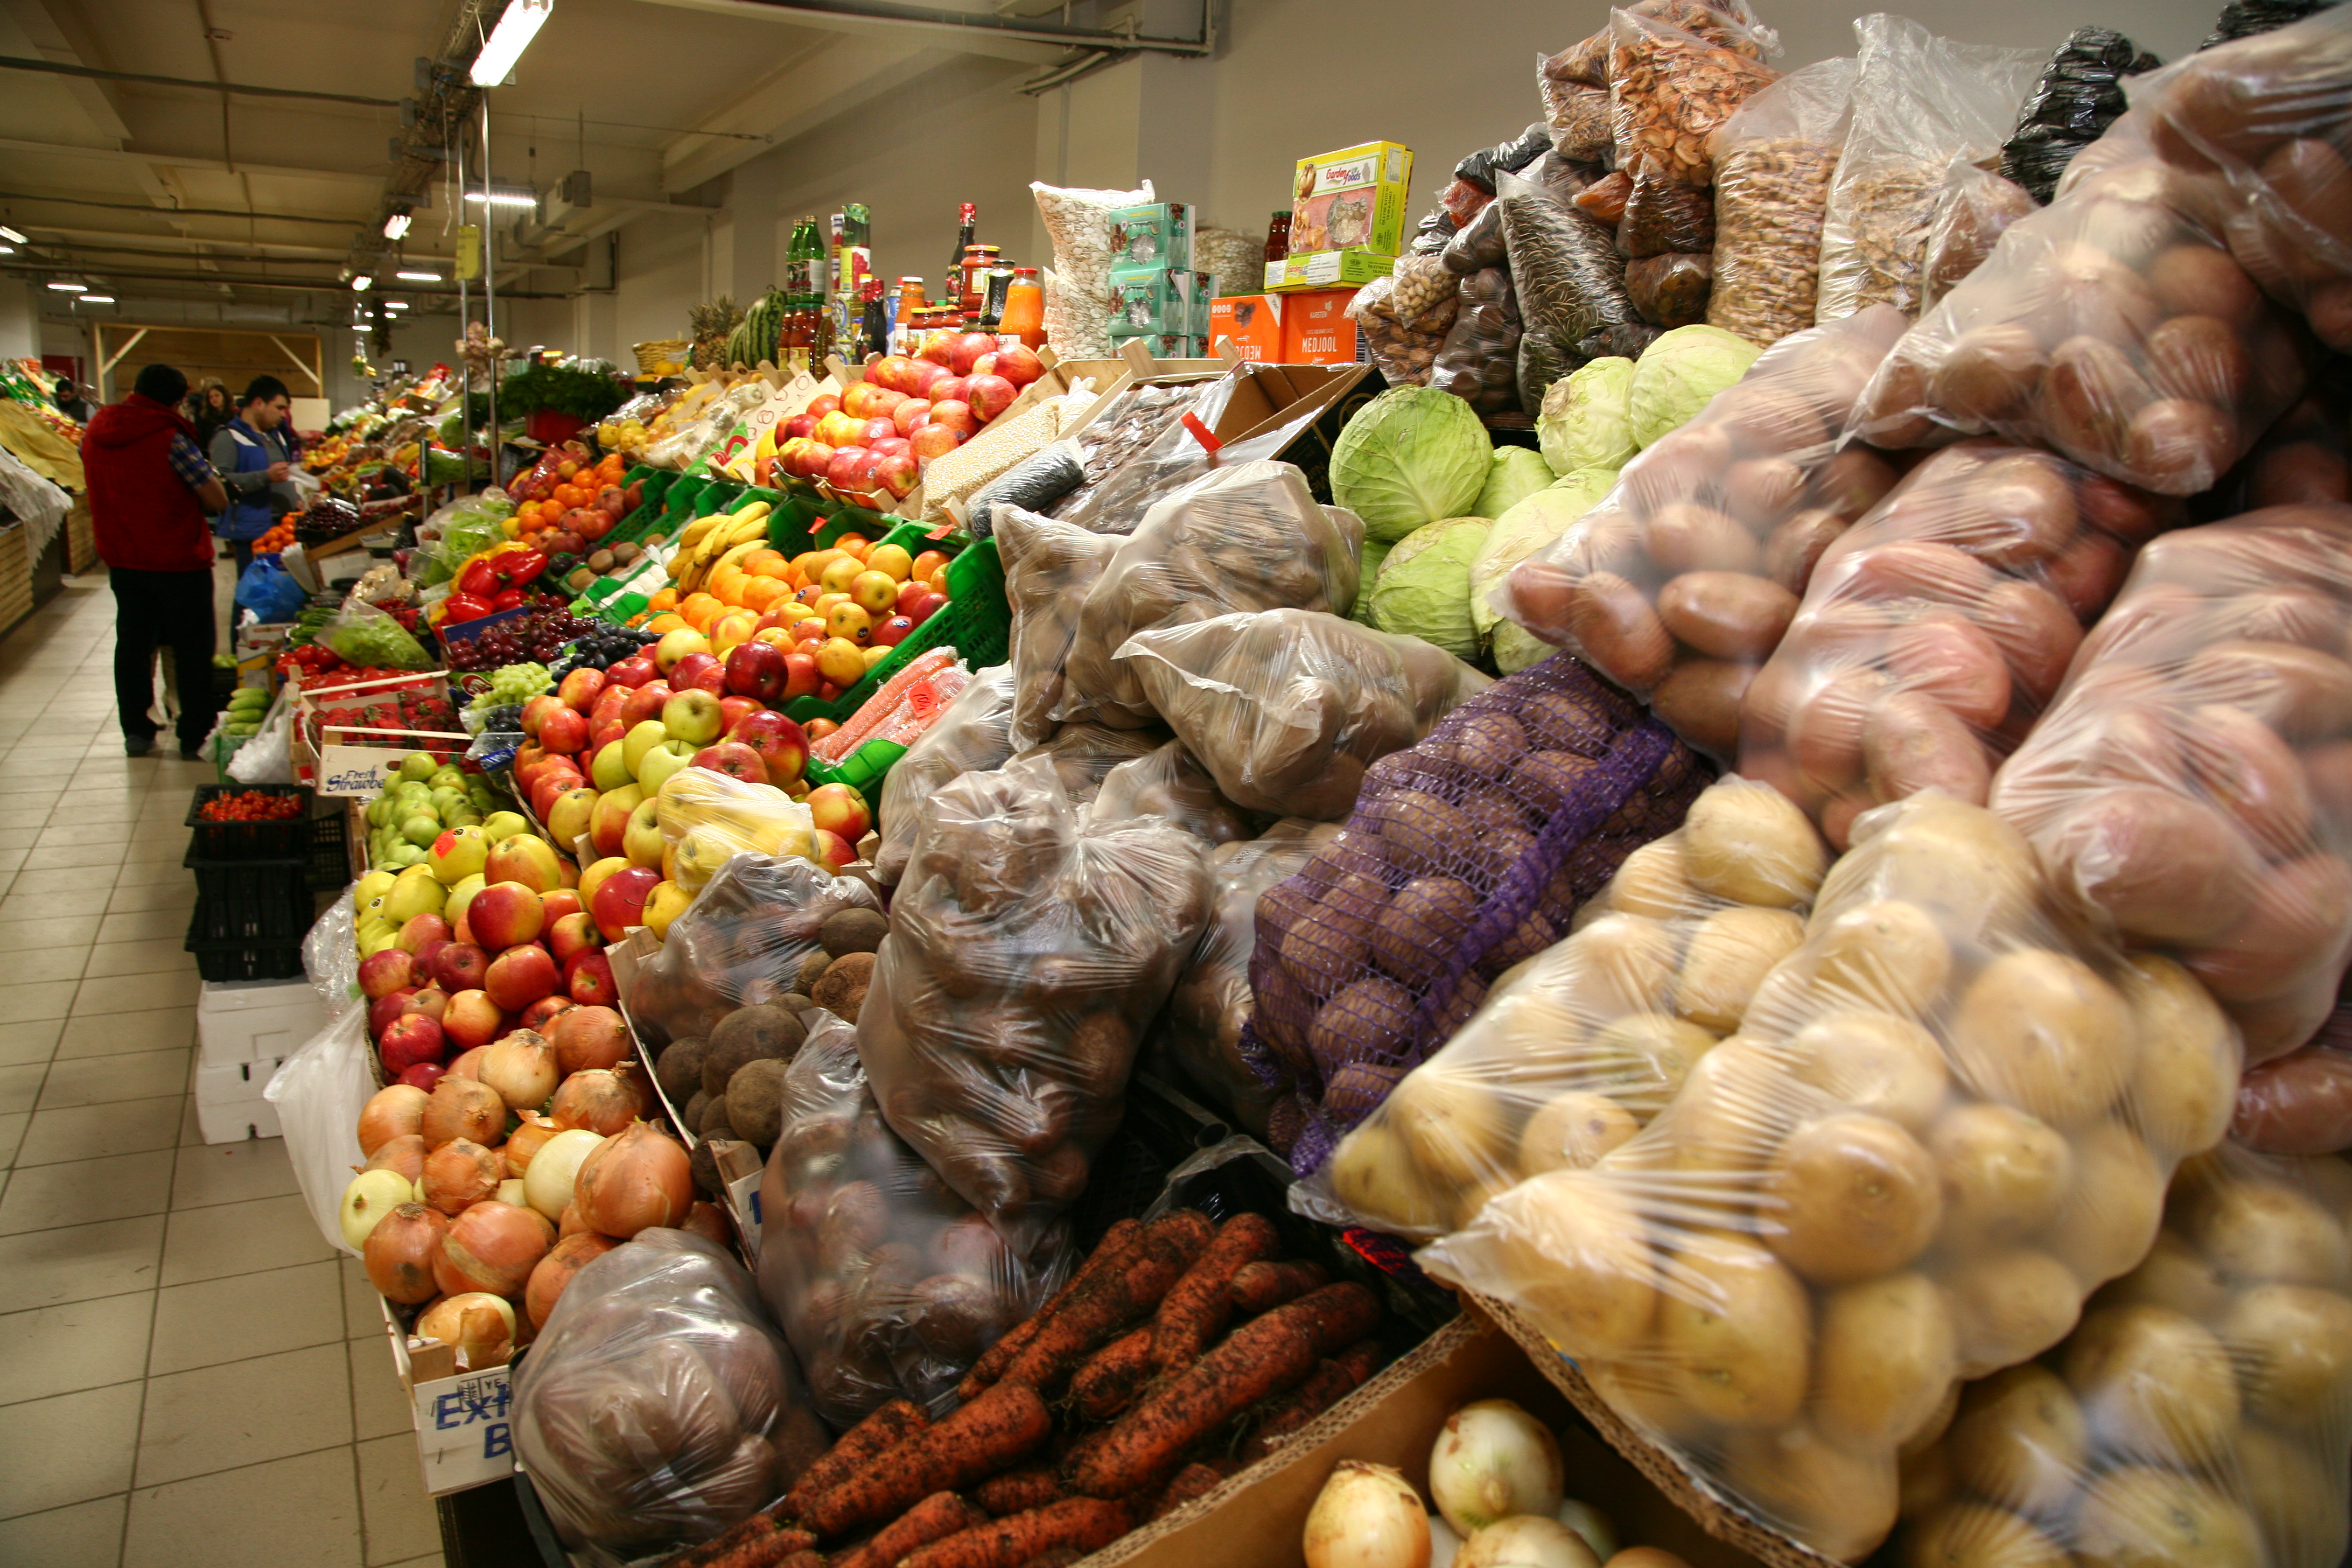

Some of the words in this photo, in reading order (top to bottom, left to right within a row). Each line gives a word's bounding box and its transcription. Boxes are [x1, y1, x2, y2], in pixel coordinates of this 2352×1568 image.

[1326, 167, 1346, 180] Garden
[1343, 169, 1361, 186] foods
[1310, 311, 1328, 319] KARSTEN
[1302, 336, 1338, 353] MEDJOOL
[345, 765, 377, 780] Fresh
